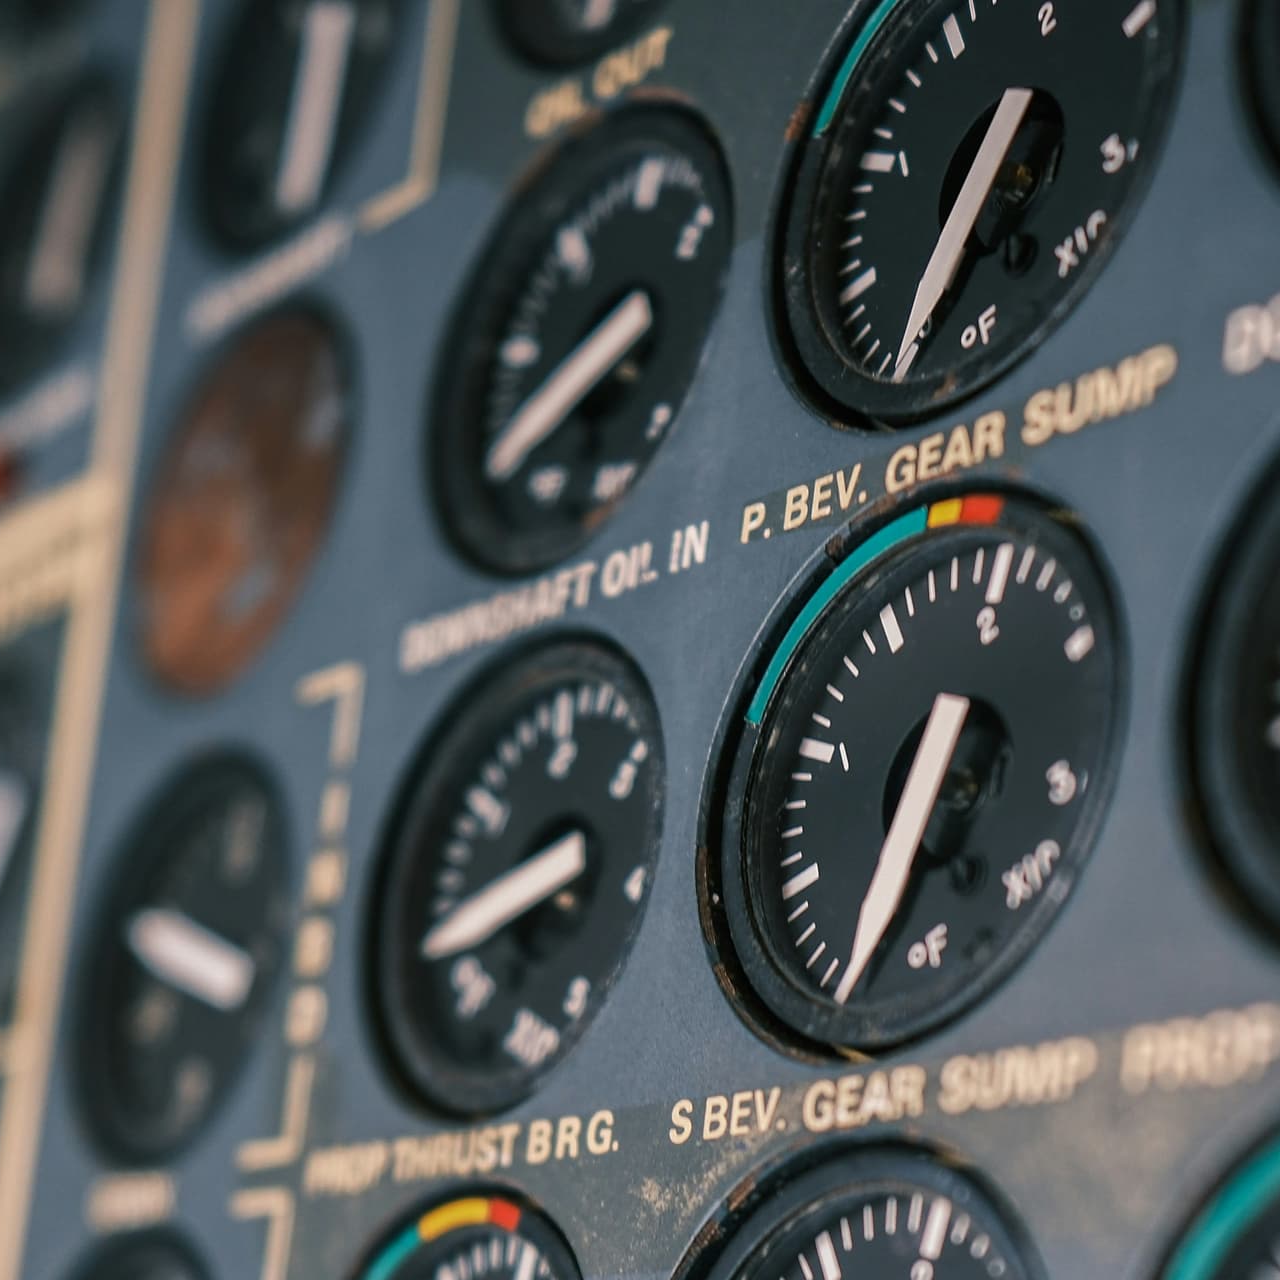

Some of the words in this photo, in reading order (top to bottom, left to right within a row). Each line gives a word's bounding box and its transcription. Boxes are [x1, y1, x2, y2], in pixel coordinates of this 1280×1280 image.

[1038, 1, 1057, 37] 2
[740, 501, 771, 544] P.
[783, 462, 867, 532] BEV.
[885, 409, 1007, 492] GEAR
[1021, 343, 1178, 446] SUMP
[600, 541, 658, 598] OIL
[669, 520, 710, 574] IN
[976, 606, 1000, 646] 2
[1046, 759, 1076, 805] 3
[668, 1099, 694, 1144] S
[702, 1087, 786, 1140] BEV.
[802, 1065, 926, 1132] GEAR
[937, 1036, 1098, 1115] SUMP
[392, 1122, 521, 1182] THRUST
[525, 1109, 619, 1164] BRG.
